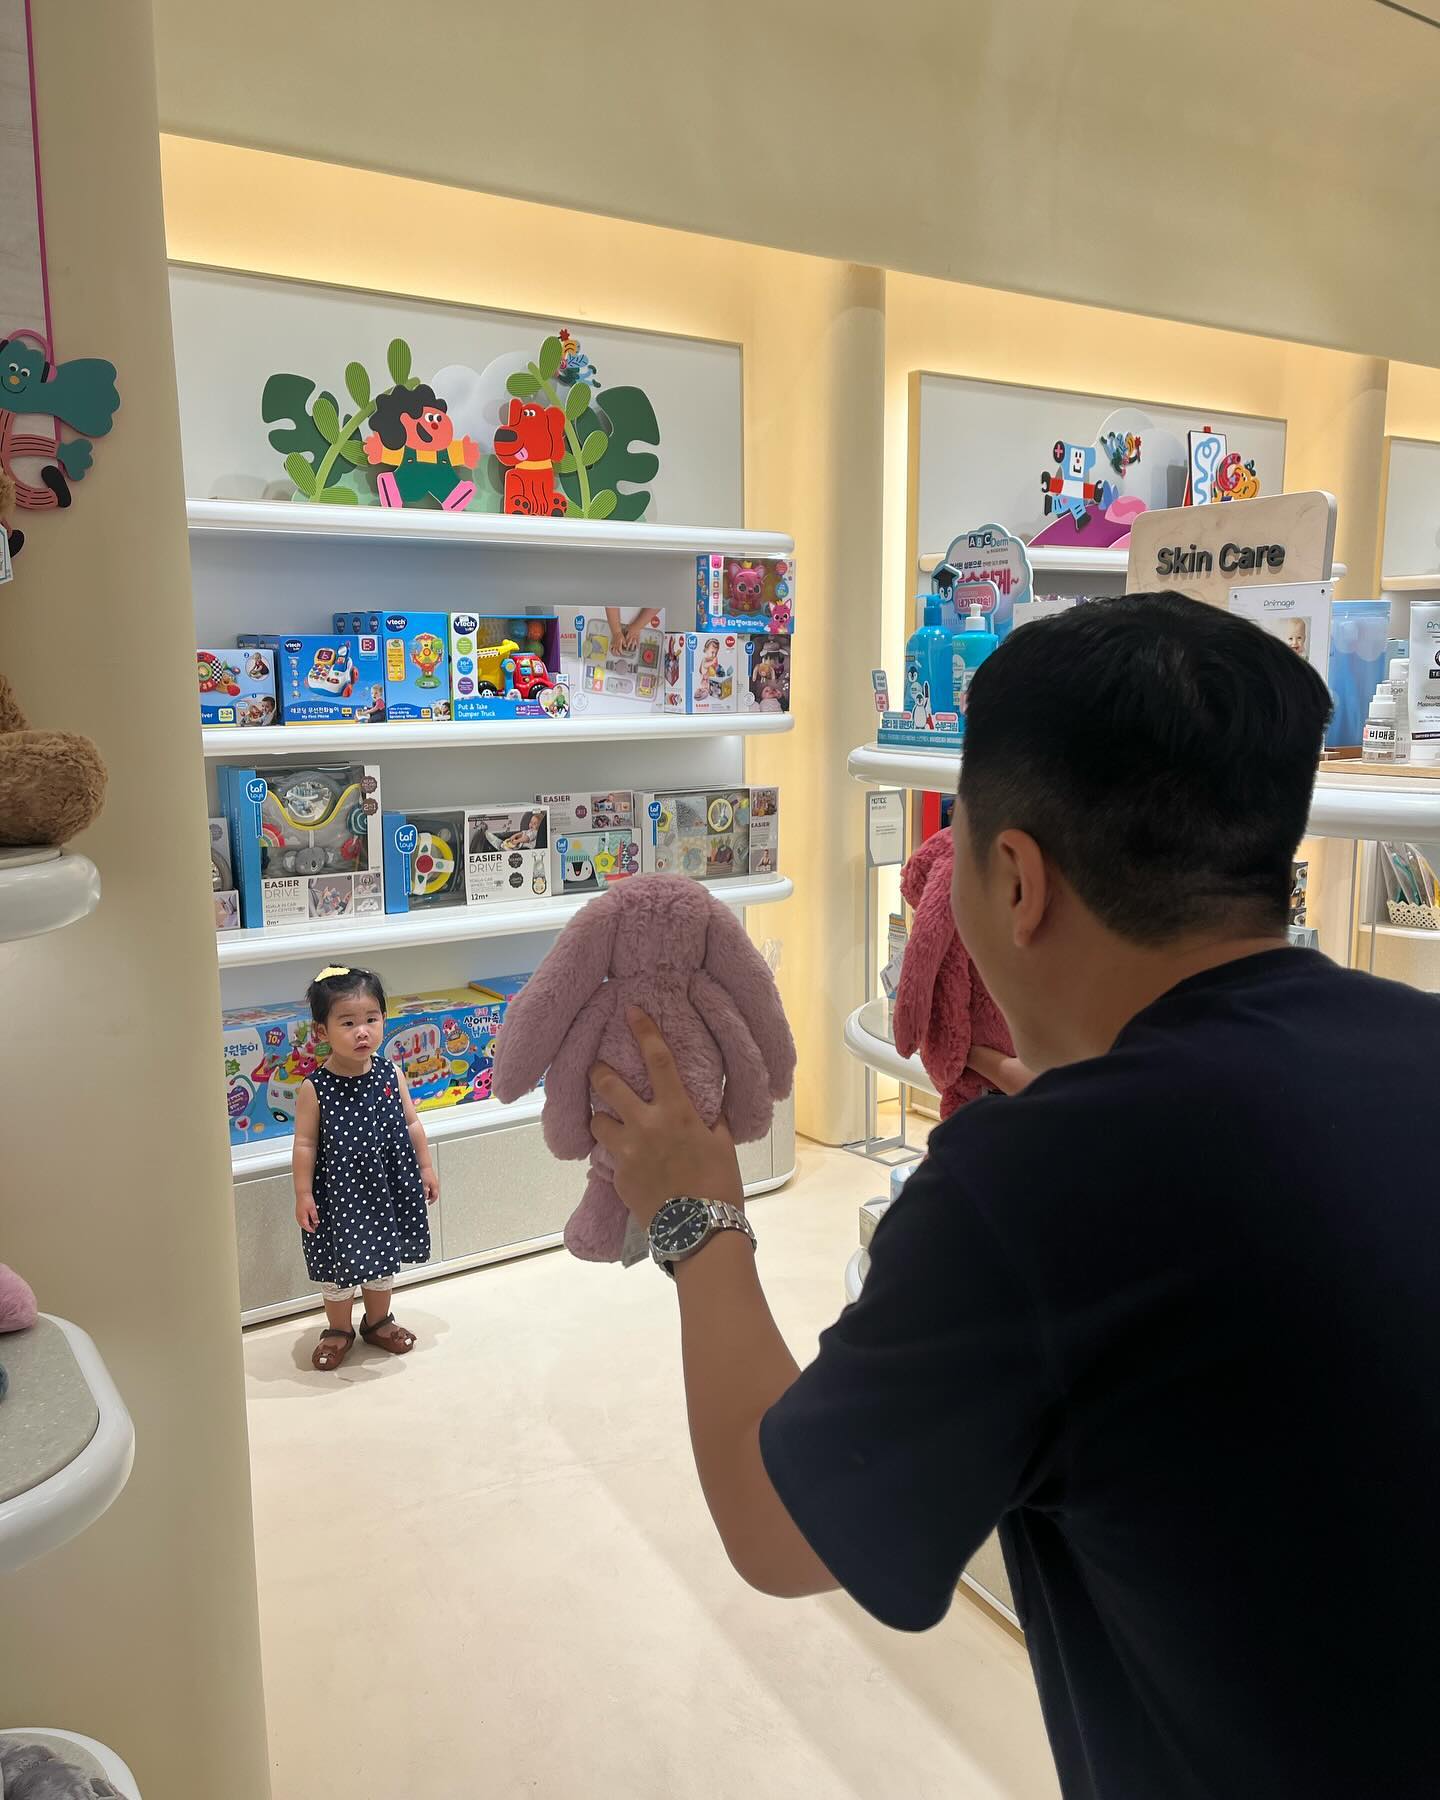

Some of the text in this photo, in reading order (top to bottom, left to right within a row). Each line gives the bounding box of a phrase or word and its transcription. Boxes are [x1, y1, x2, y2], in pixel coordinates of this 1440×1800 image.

[1156, 542, 1286, 576] Skin Care
[480, 709, 496, 718] Truck
[1369, 730, 1395, 741] 비매품
[249, 783, 264, 793] taf
[543, 795, 571, 803] EASIER
[399, 830, 414, 842] taf
[469, 853, 503, 863] EASIER
[469, 862, 503, 874] DRIVE
[264, 879, 300, 889] EASIER
[264, 888, 300, 900] DRIVE
[463, 1010, 499, 1028] 상어가족
